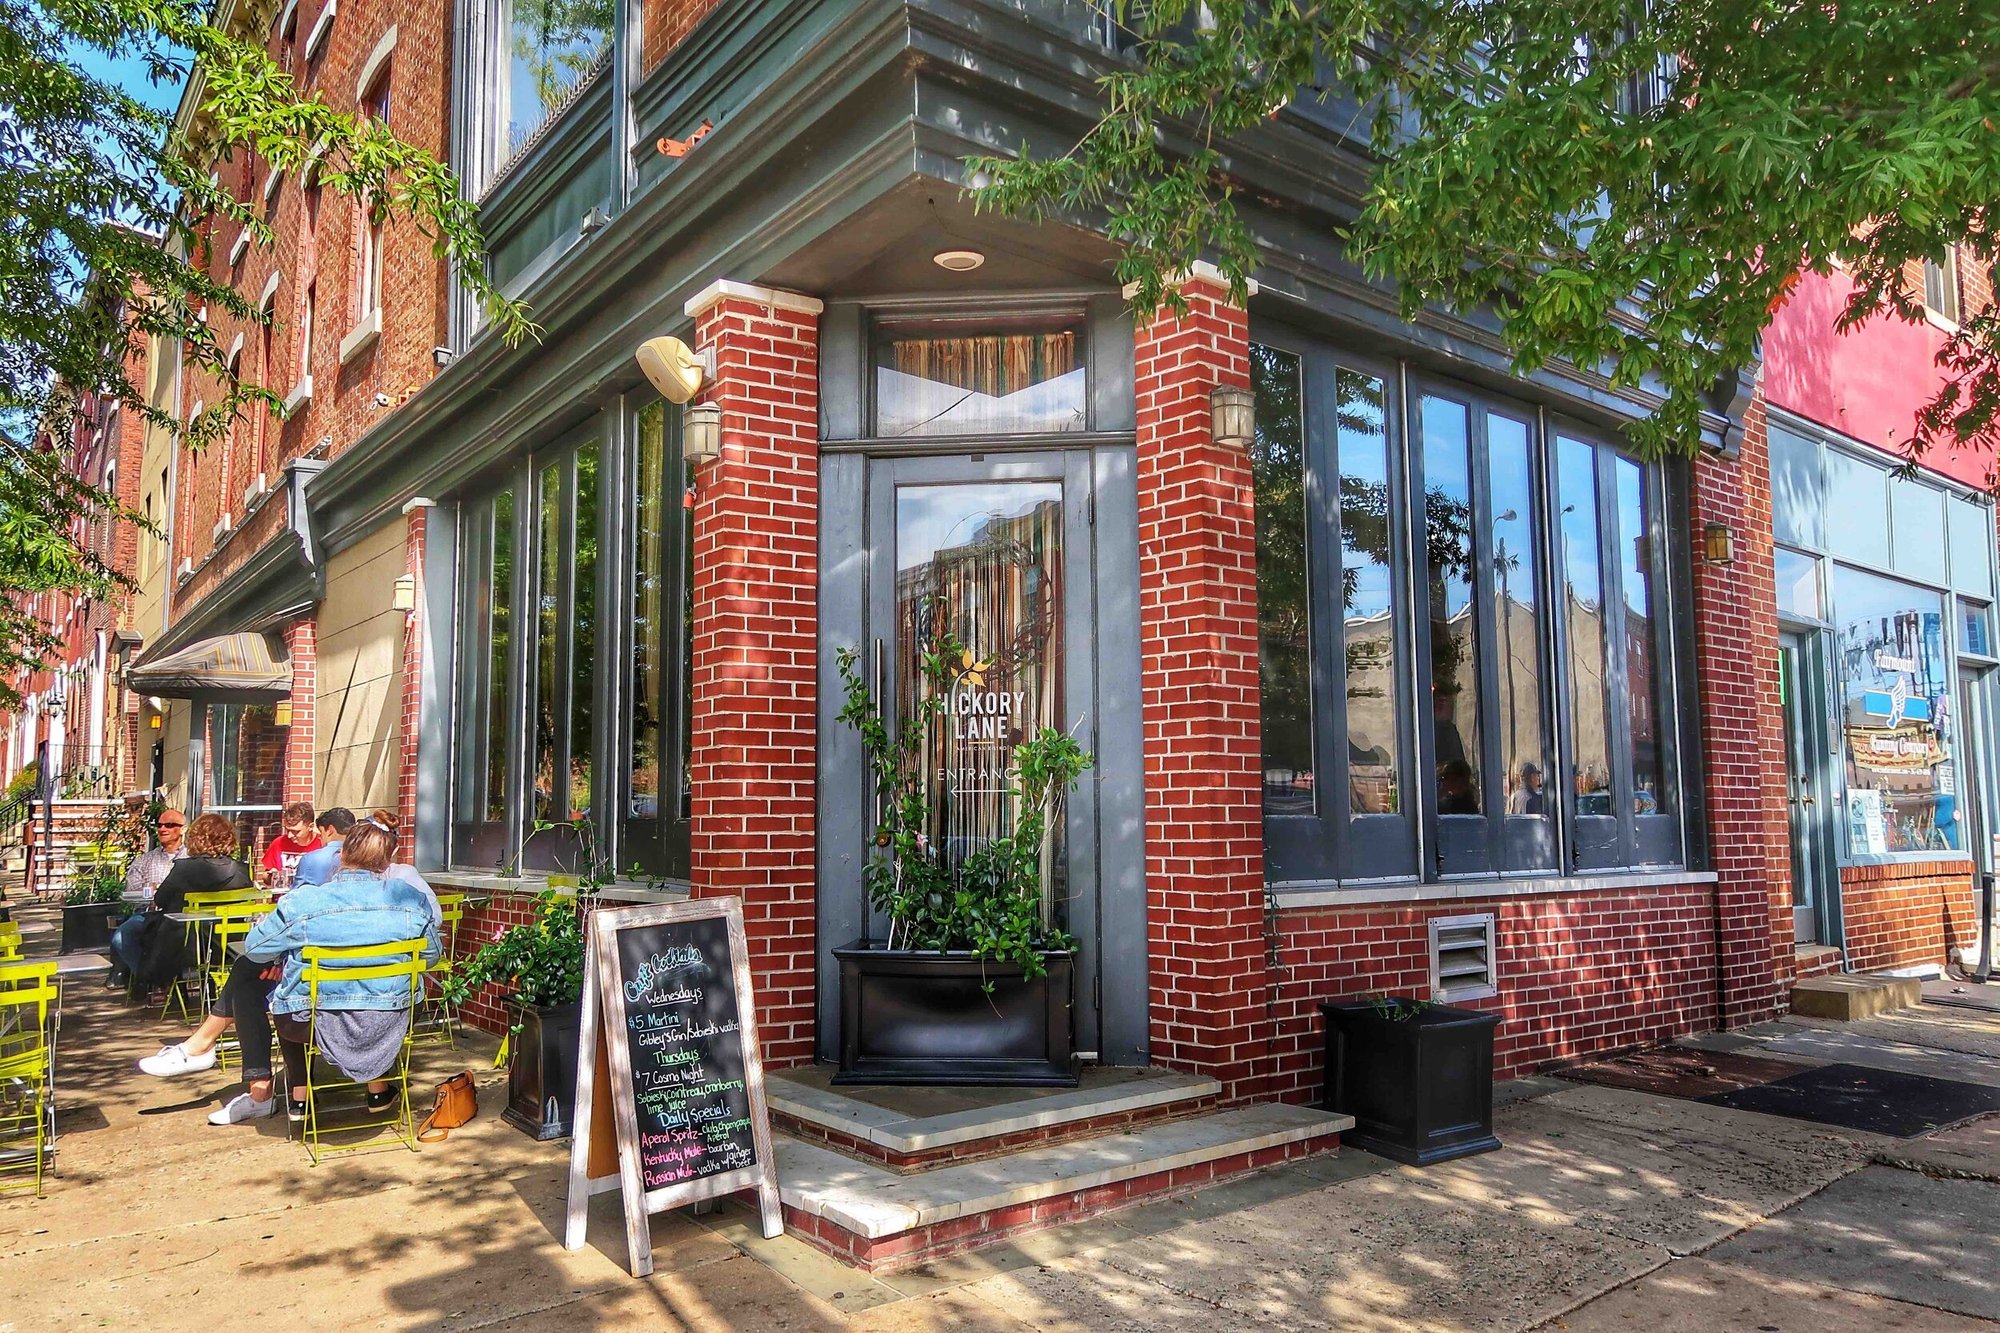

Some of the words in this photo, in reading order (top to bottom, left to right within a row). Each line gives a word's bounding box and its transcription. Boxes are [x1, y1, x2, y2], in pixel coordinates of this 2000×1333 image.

[937, 692, 1025, 715] HICKORY
[955, 716, 1008, 739] LANE
[938, 767, 1024, 781] ENTRANC
[651, 943, 703, 973] Cocktails
[646, 984, 703, 1005] Wednesdays
[647, 1011, 680, 1028] Martini
[653, 1047, 701, 1066] Thursdays
[652, 1070, 680, 1085] Cosmo
[680, 1063, 705, 1084] Night
[646, 1103, 664, 1115] lime
[667, 1099, 687, 1114] juice
[657, 1110, 691, 1130] Daily
[691, 1099, 731, 1123] Specials
[641, 1131, 670, 1149] Aperol
[643, 1147, 684, 1167] Kentucky
[734, 1157, 752, 1168] beer
[643, 1169, 676, 1188] Russian
